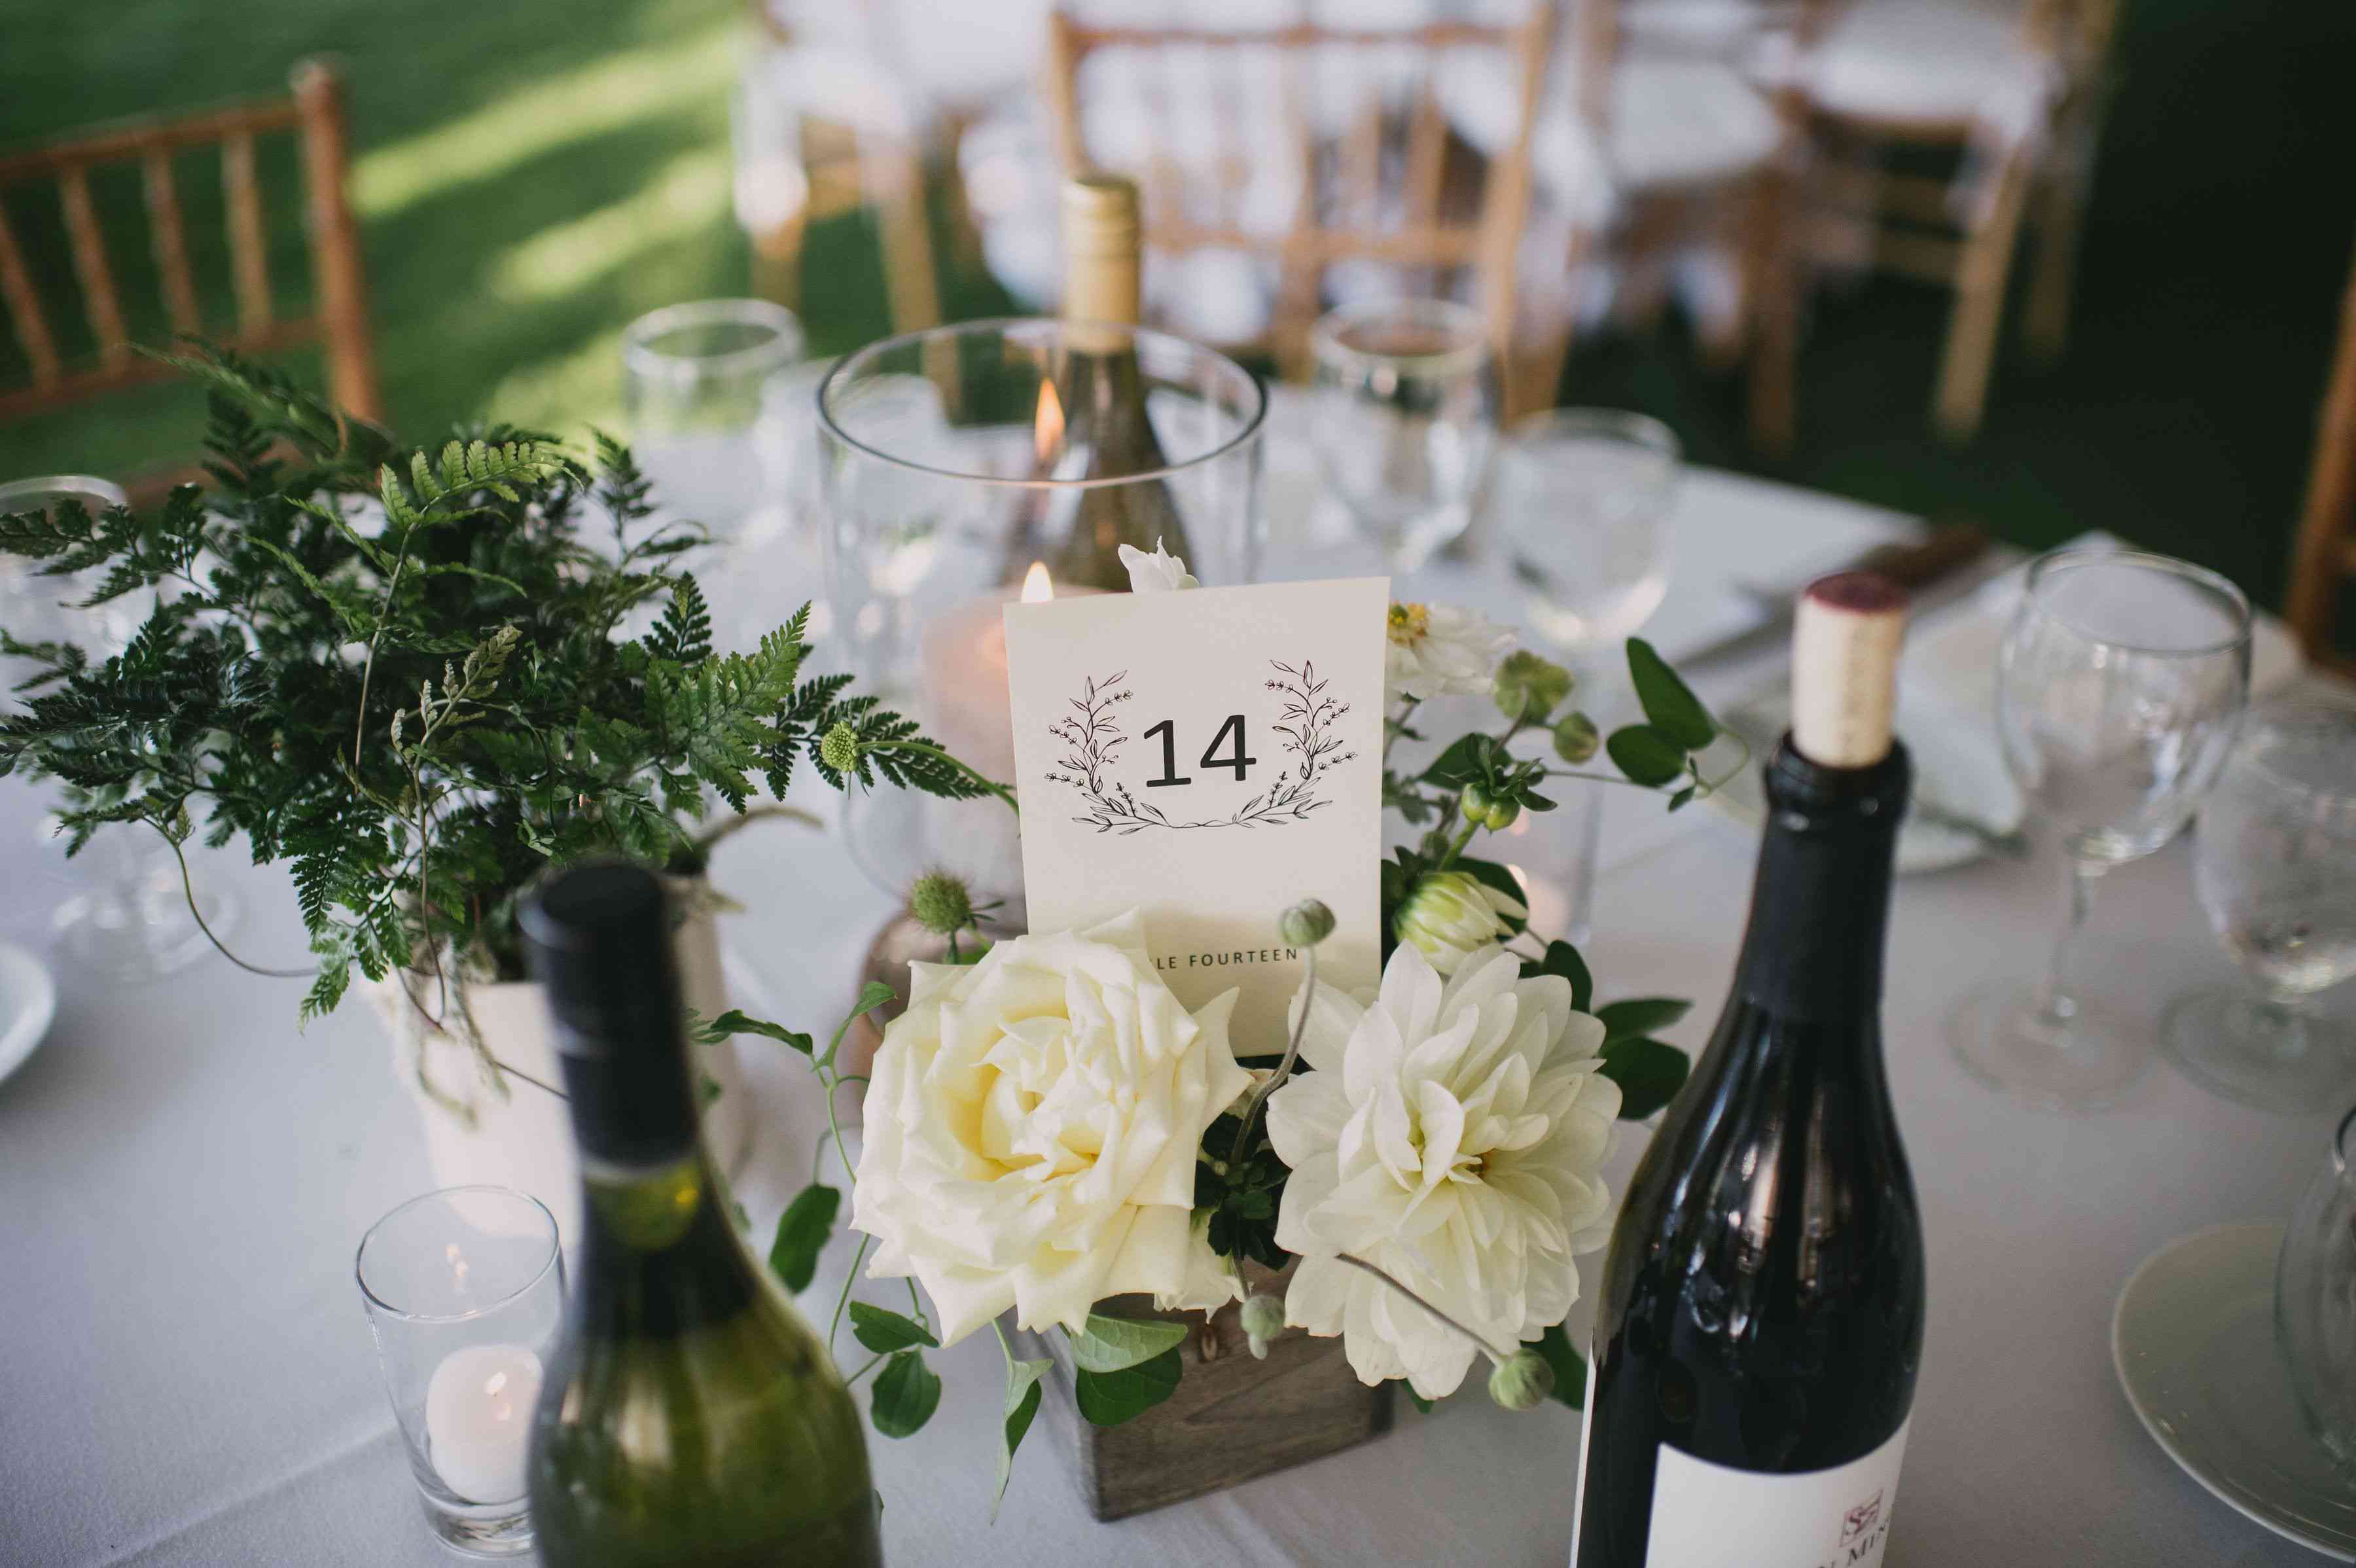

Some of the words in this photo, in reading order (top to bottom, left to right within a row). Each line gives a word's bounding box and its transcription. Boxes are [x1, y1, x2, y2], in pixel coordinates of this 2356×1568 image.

[1144, 715, 1257, 787] 14
[1156, 956, 1177, 970] LE
[1189, 948, 1298, 967] FOURTEEN
